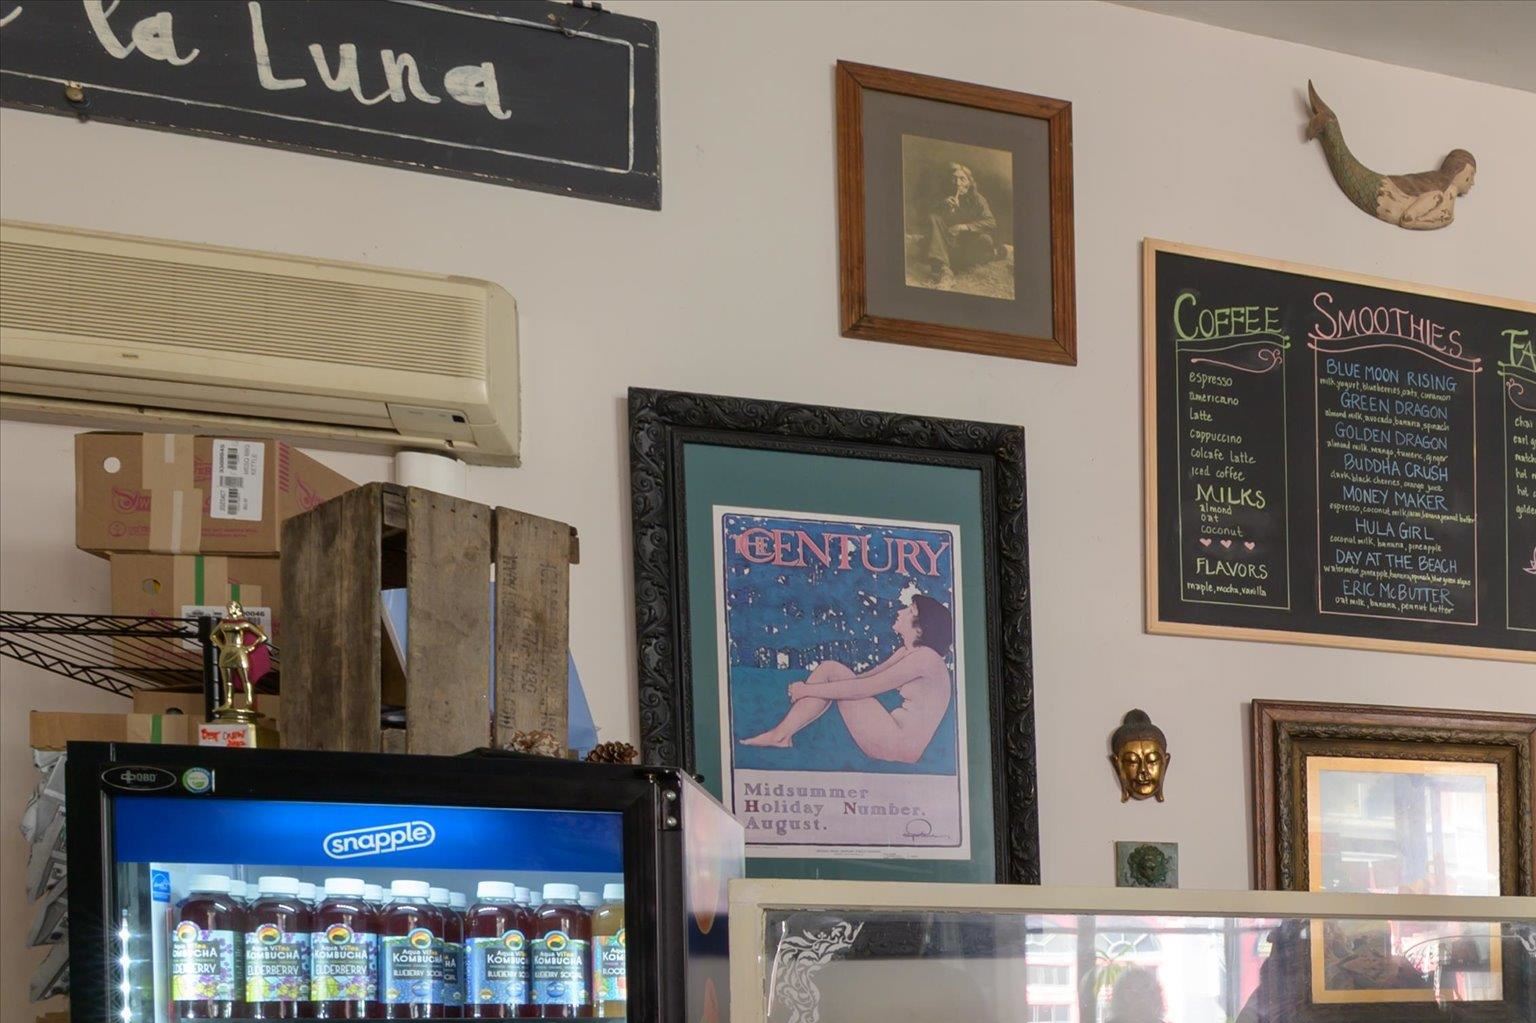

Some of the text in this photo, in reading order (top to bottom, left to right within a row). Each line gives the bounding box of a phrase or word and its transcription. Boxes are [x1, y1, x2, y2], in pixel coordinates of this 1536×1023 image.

[248, 1, 512, 120] Luna
[1174, 293, 1282, 339] COFFEE
[1313, 292, 1462, 358] SMOOTHIES
[1189, 371, 1233, 389] espresso
[1326, 358, 1457, 392] BLUE MOON RISING
[1189, 391, 1239, 406] americano
[1340, 391, 1448, 420] GREEN DRAGON
[1190, 428, 1242, 445] cappuccino
[1335, 421, 1448, 450] GOLDEN DRAGON
[1216, 466, 1246, 482] coffee
[1344, 453, 1448, 482] BUDDHA CRUSH
[1195, 484, 1266, 509] MILKS
[1342, 485, 1449, 511] MONEY MAKER
[1200, 502, 1232, 515] almond
[1201, 514, 1219, 523] oat
[1201, 524, 1244, 537] coconut
[1355, 518, 1435, 541] HULA GIRL
[739, 528, 949, 577] CENTURY
[1335, 548, 1458, 574] DAY AT THE BEACH
[1196, 557, 1269, 580] FLAVORS
[1343, 579, 1375, 597] ERIC
[744, 783, 869, 799] Midsummer
[744, 800, 926, 818] Holiday Number.
[331, 821, 429, 854] snapple
[744, 818, 828, 835] August.
[314, 950, 368, 960] KOMBUCHA
